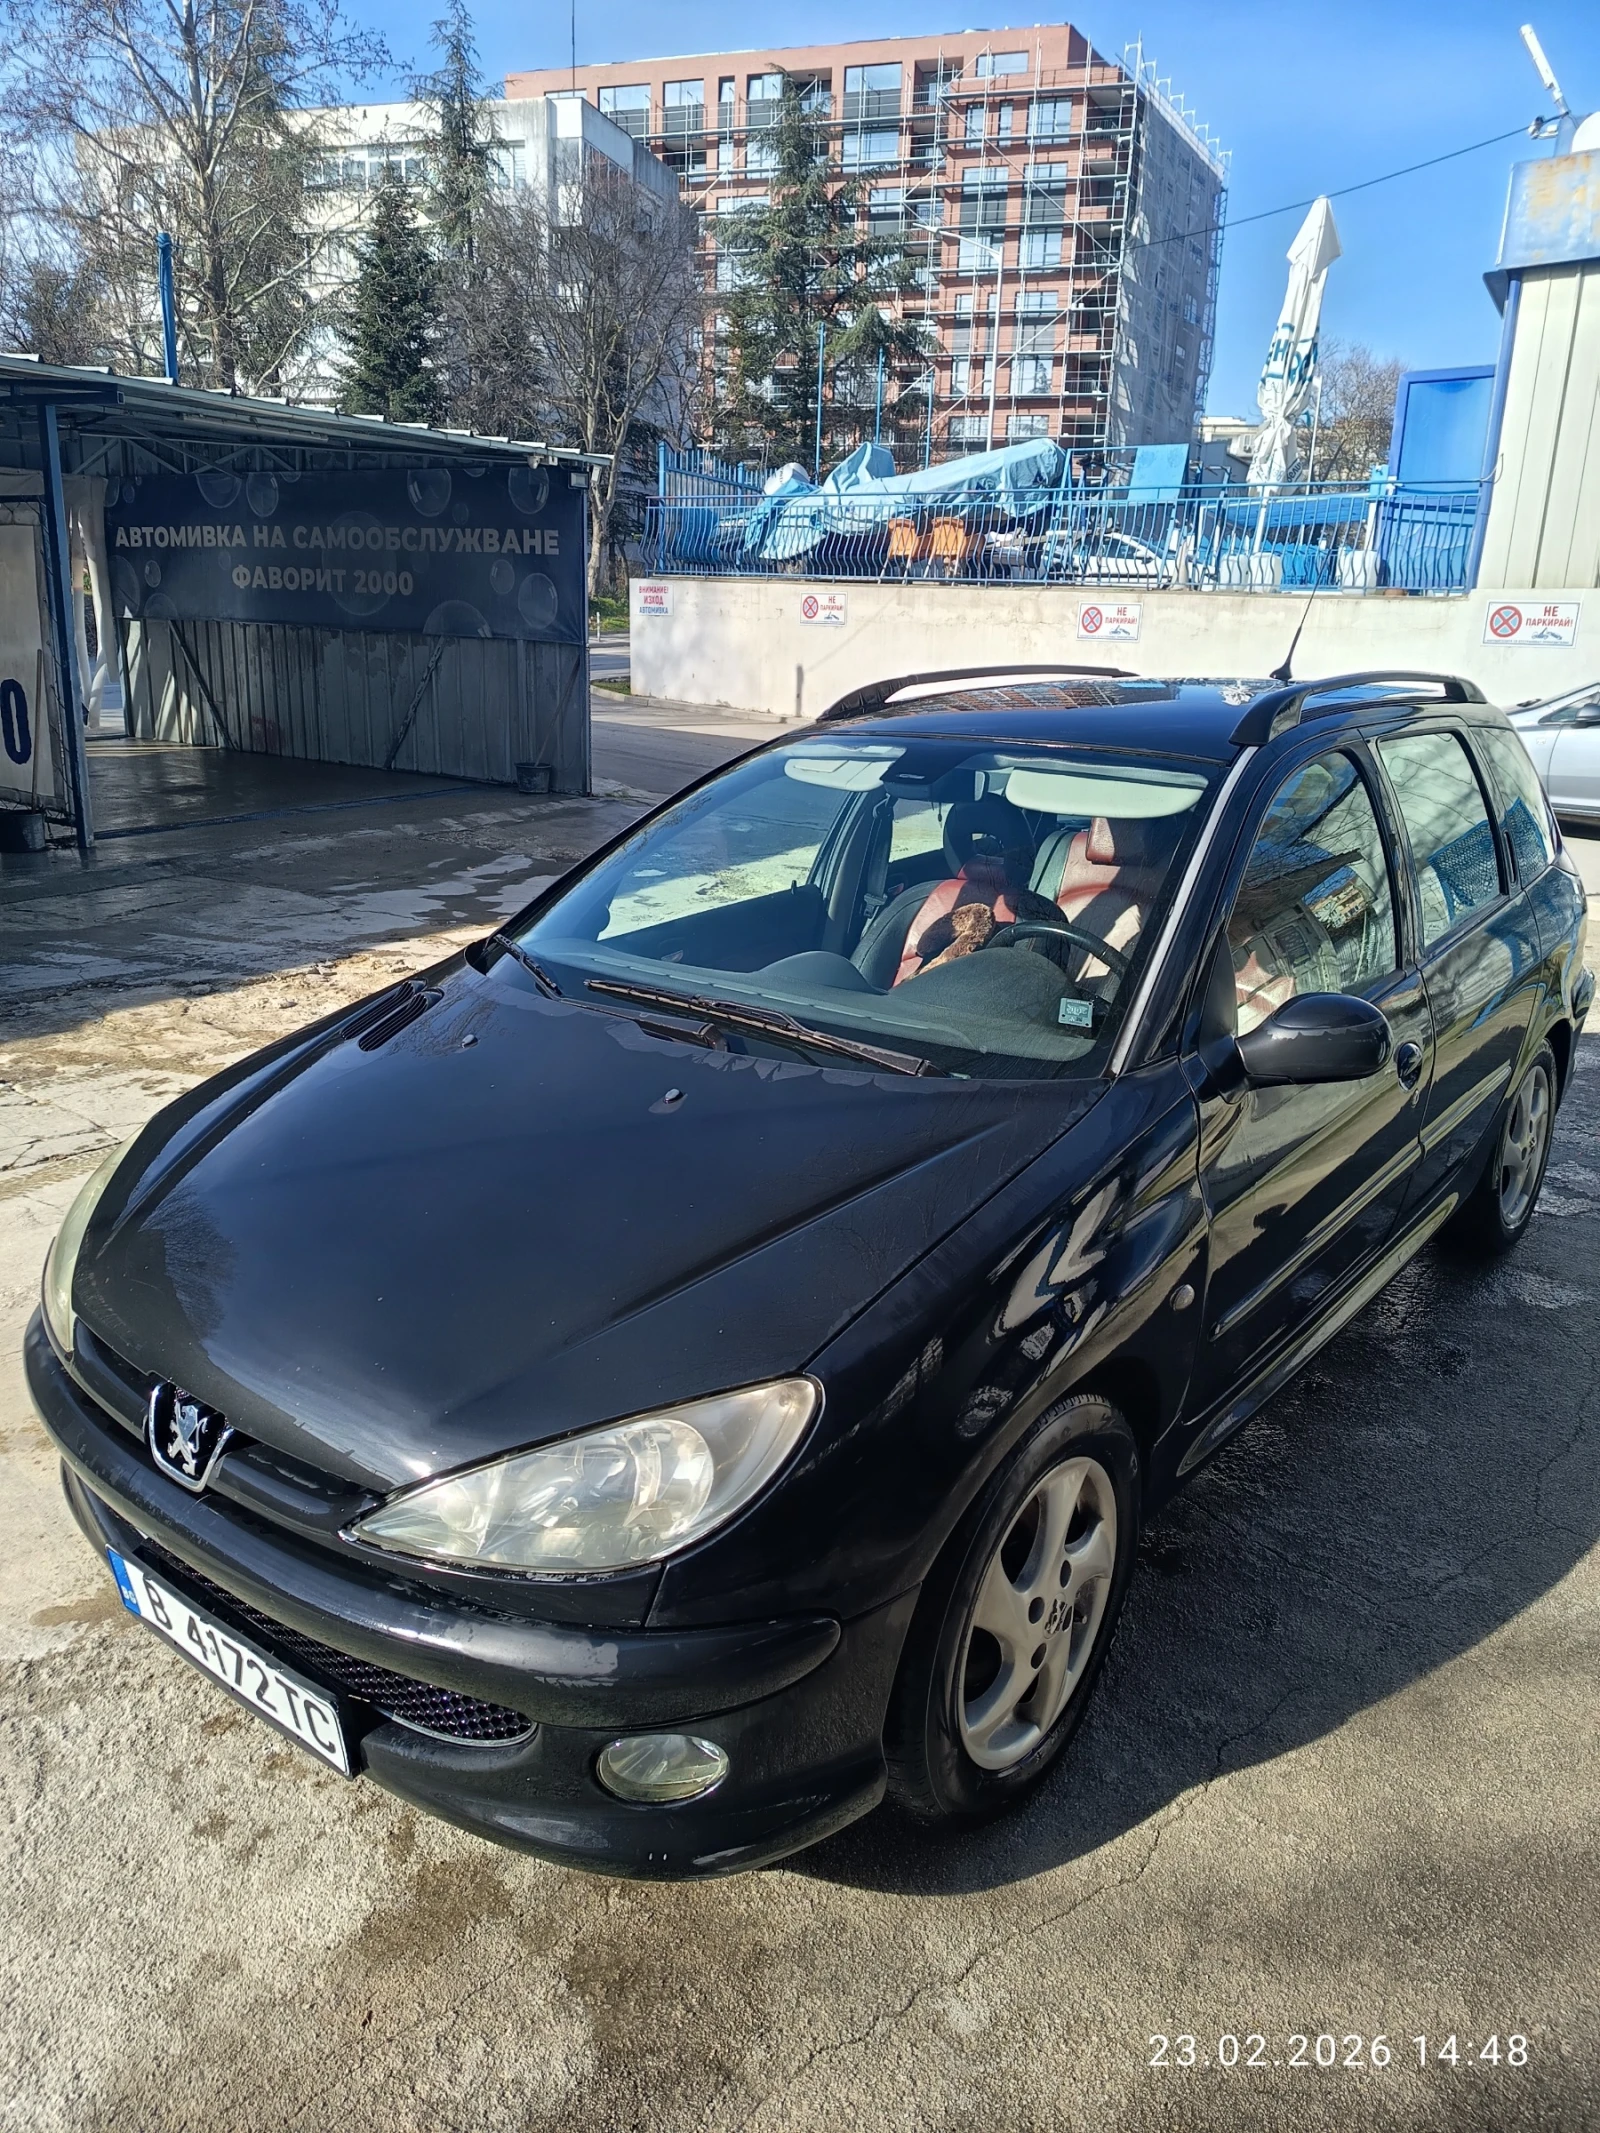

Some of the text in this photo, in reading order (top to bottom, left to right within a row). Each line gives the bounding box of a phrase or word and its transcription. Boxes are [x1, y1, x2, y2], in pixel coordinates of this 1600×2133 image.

[115, 525, 560, 555] АВТОМИВКА НА САМООБСЛУЖВАНЕ
[231, 564, 413, 596] ФАВОРИТ 2000
[638, 585, 669, 594] ВНИМАНИЕ!
[643, 595, 664, 606] ИЗХОД
[828, 595, 837, 604] НЕ
[638, 606, 669, 614] АВТОМИВКА
[1116, 606, 1128, 616] НЕ
[1543, 605, 1560, 617] НЕ
[1104, 616, 1138, 625] ПАРКИРАЙ!
[1525, 616, 1574, 628] ПАРКИРАЙ!
[120, 1585, 137, 1605] BG
